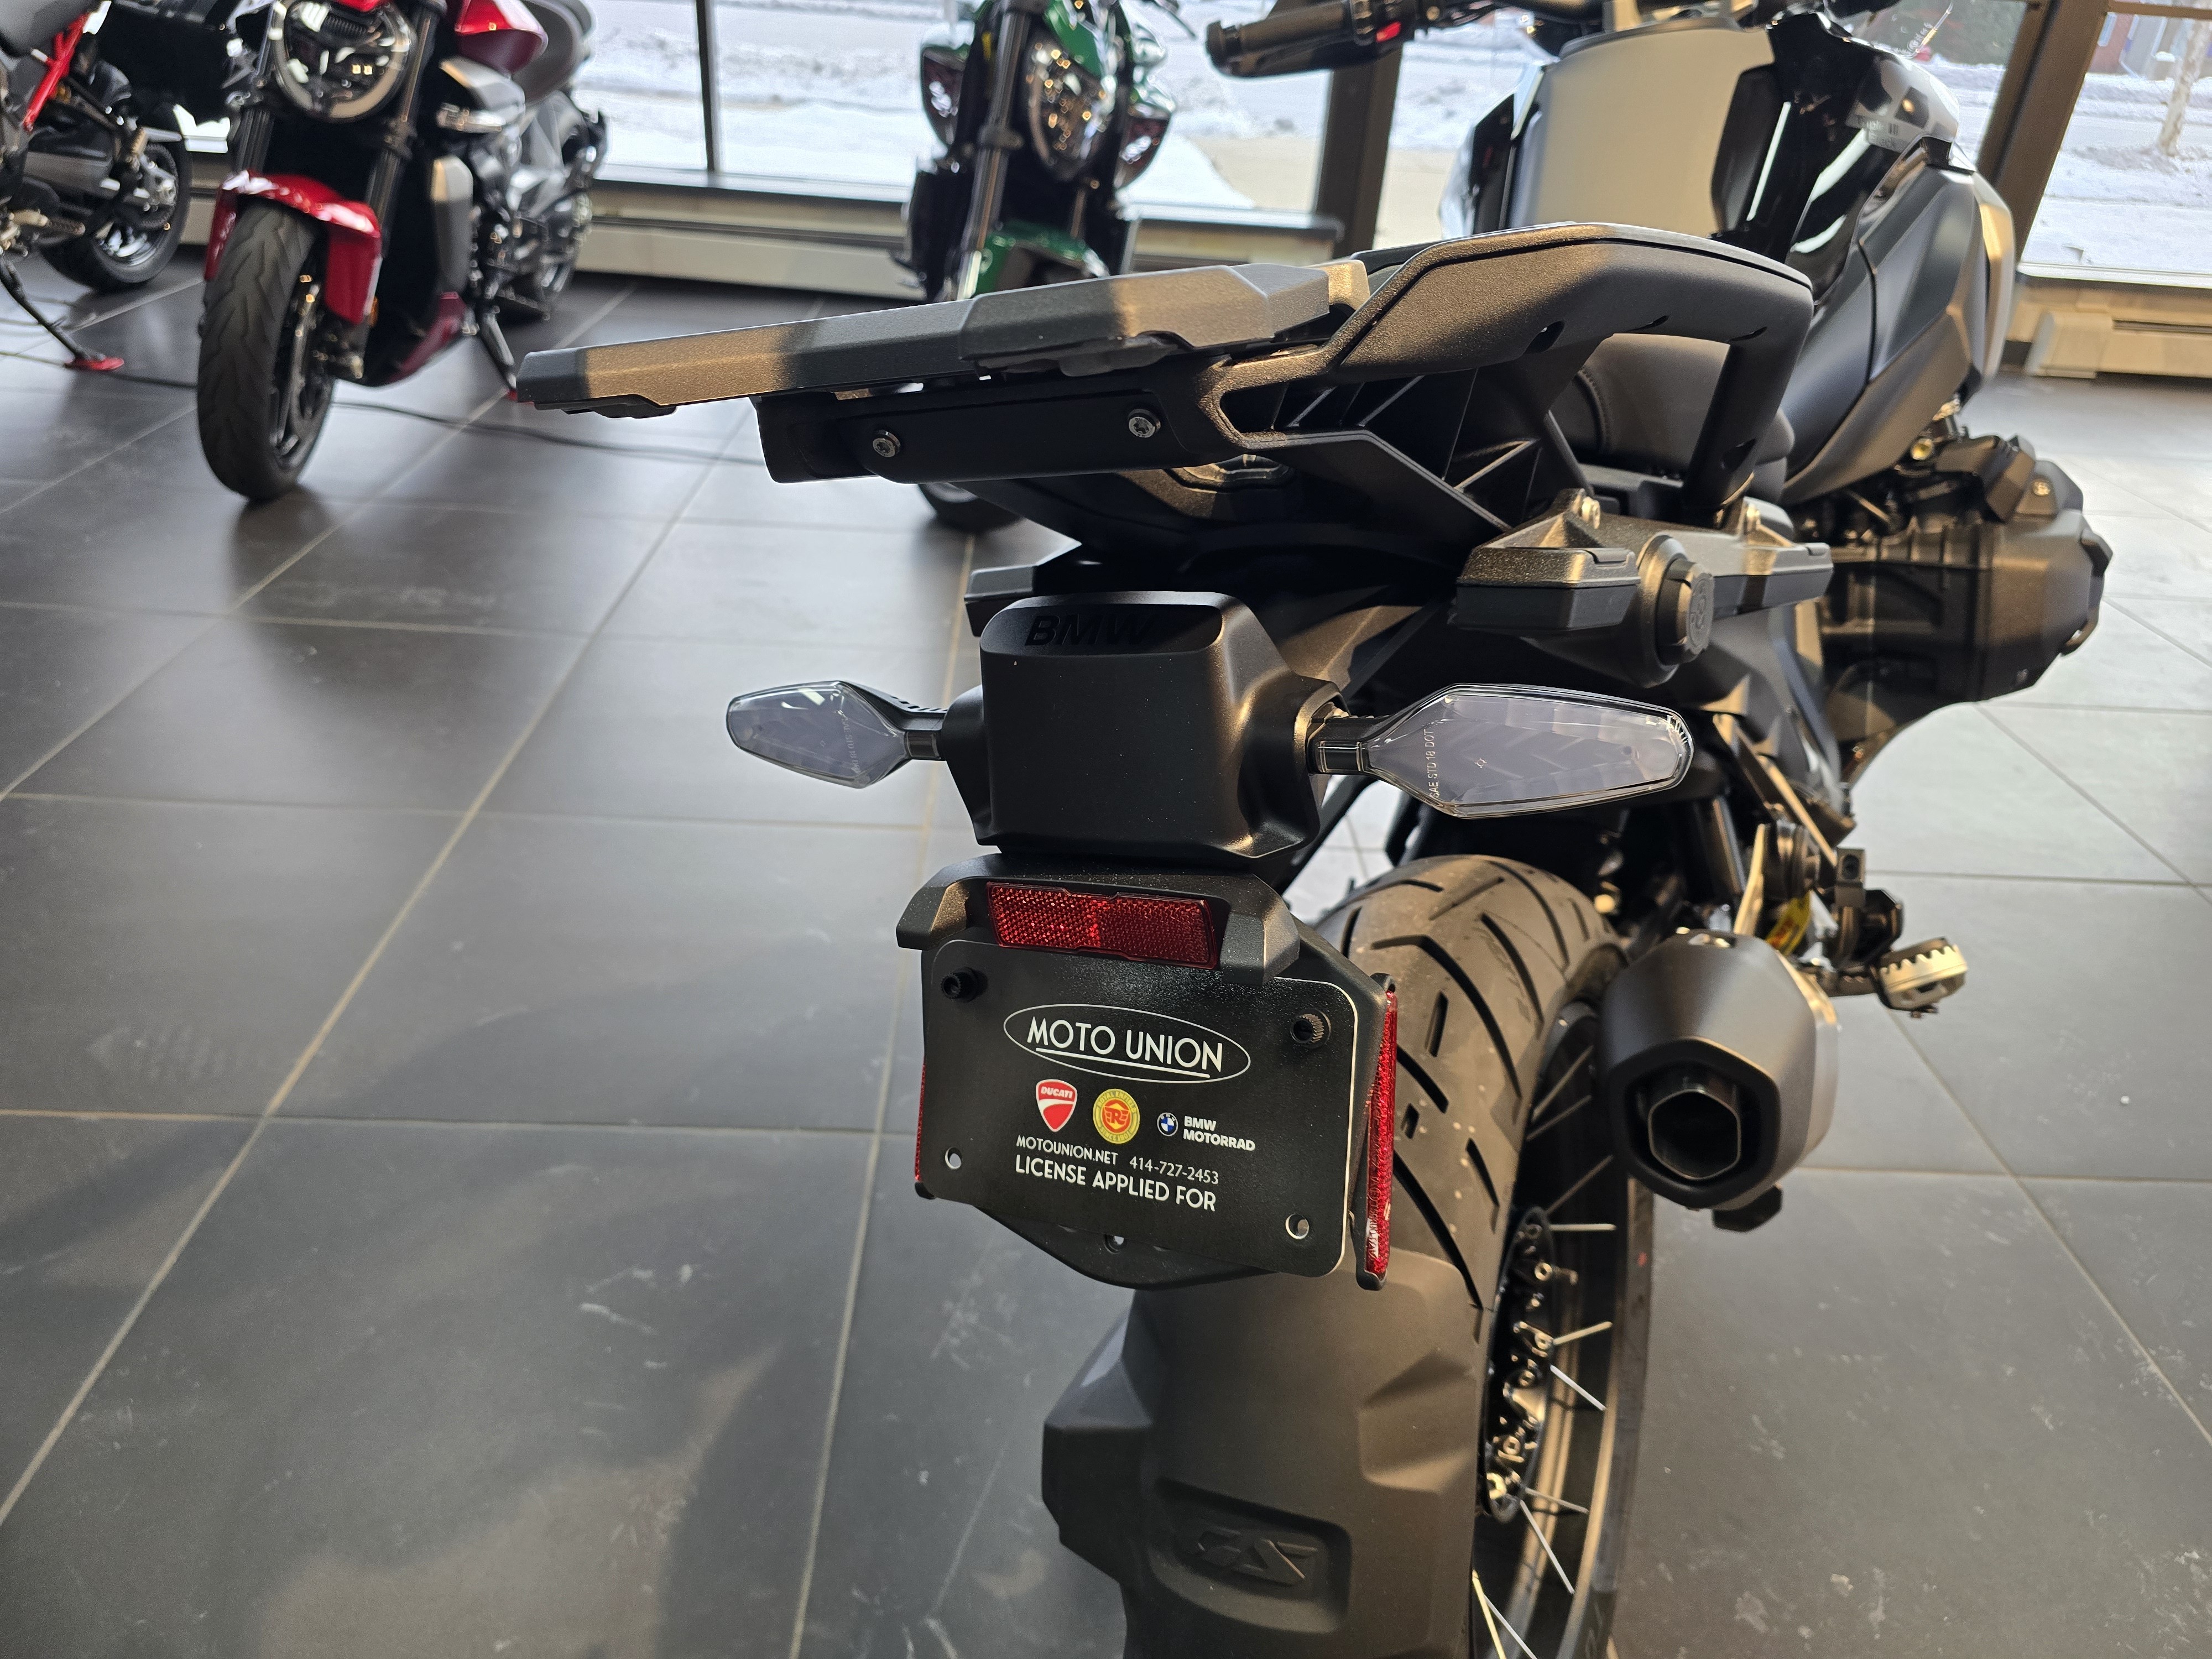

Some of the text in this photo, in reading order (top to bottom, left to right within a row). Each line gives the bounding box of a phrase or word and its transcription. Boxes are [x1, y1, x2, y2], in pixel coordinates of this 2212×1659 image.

[1025, 613, 1160, 646] BMW
[1423, 729, 1440, 799] SAE STD 18 DOT
[1027, 1016, 1223, 1072] MOTO UNION
[1040, 1086, 1073, 1098] DUCATI
[1097, 1090, 1136, 1114] ROYAL ENFIELD
[1184, 1115, 1217, 1131] BMW
[1183, 1129, 1256, 1151] MOTORRAD
[1016, 1135, 1219, 1185] MOTOUNION.NET 414-727-2453
[1015, 1154, 1216, 1212] LICENSE APPLIED FOR
